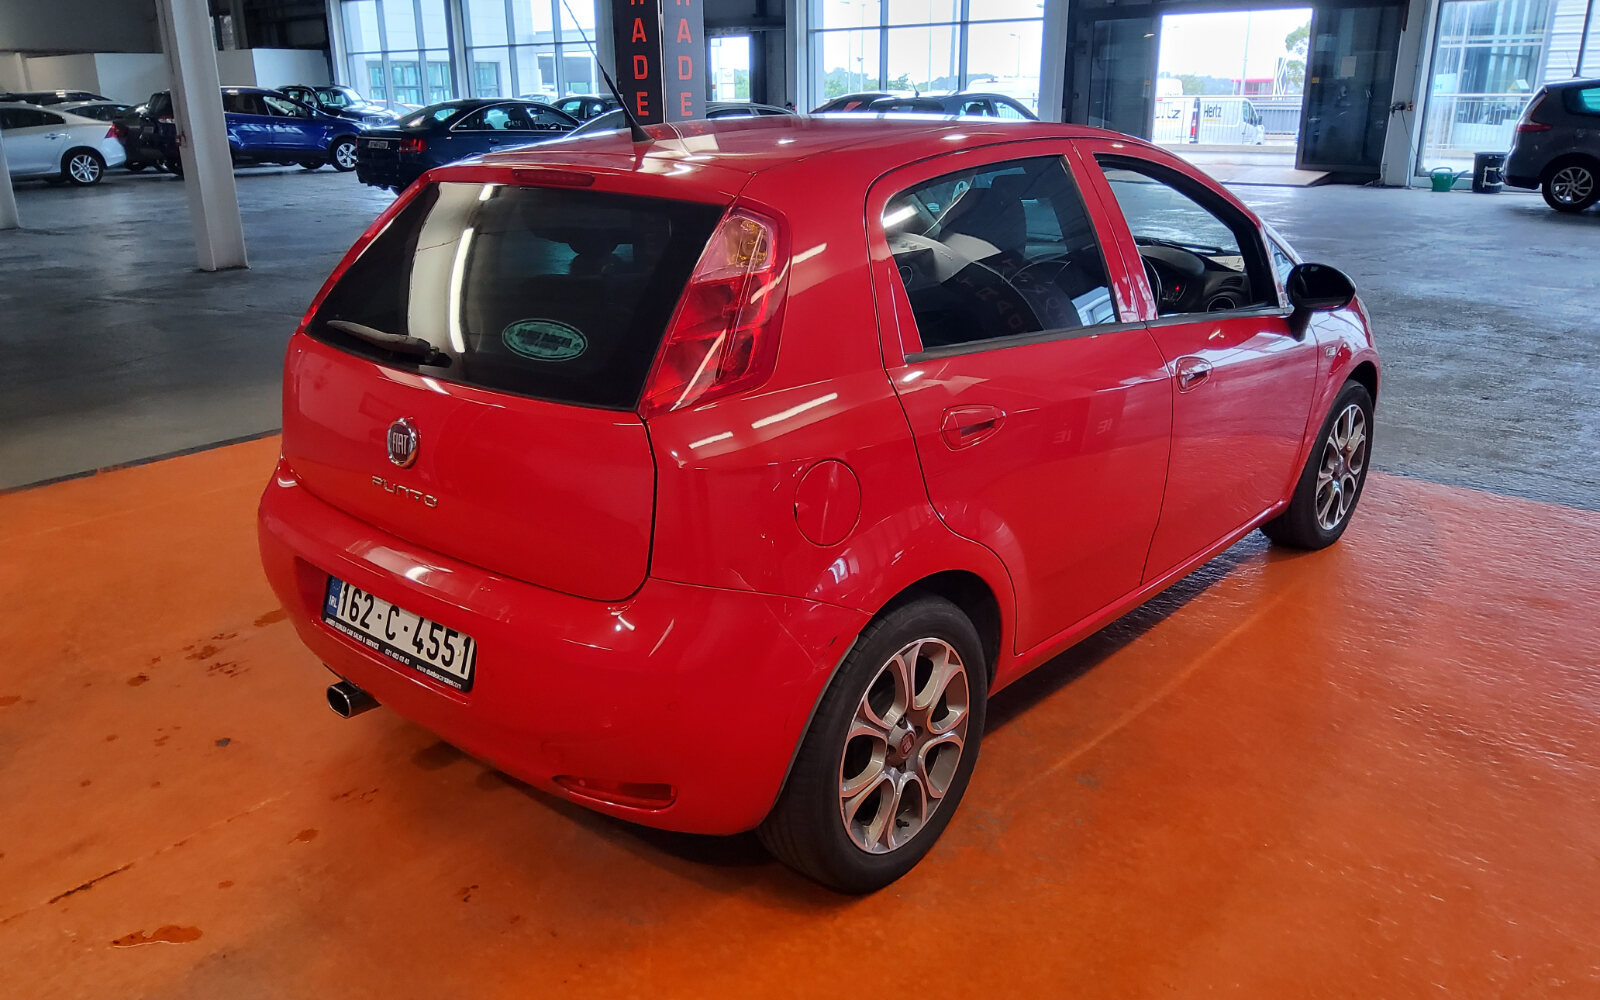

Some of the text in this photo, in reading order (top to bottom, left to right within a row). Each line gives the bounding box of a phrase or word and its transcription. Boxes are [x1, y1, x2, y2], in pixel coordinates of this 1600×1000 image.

[630, 0, 649, 116] ADE
[676, 0, 693, 116] ADE
[1203, 104, 1222, 118] Hertz
[392, 432, 408, 455] FIAT
[371, 475, 438, 508] PUNTO
[328, 594, 338, 609] IRL
